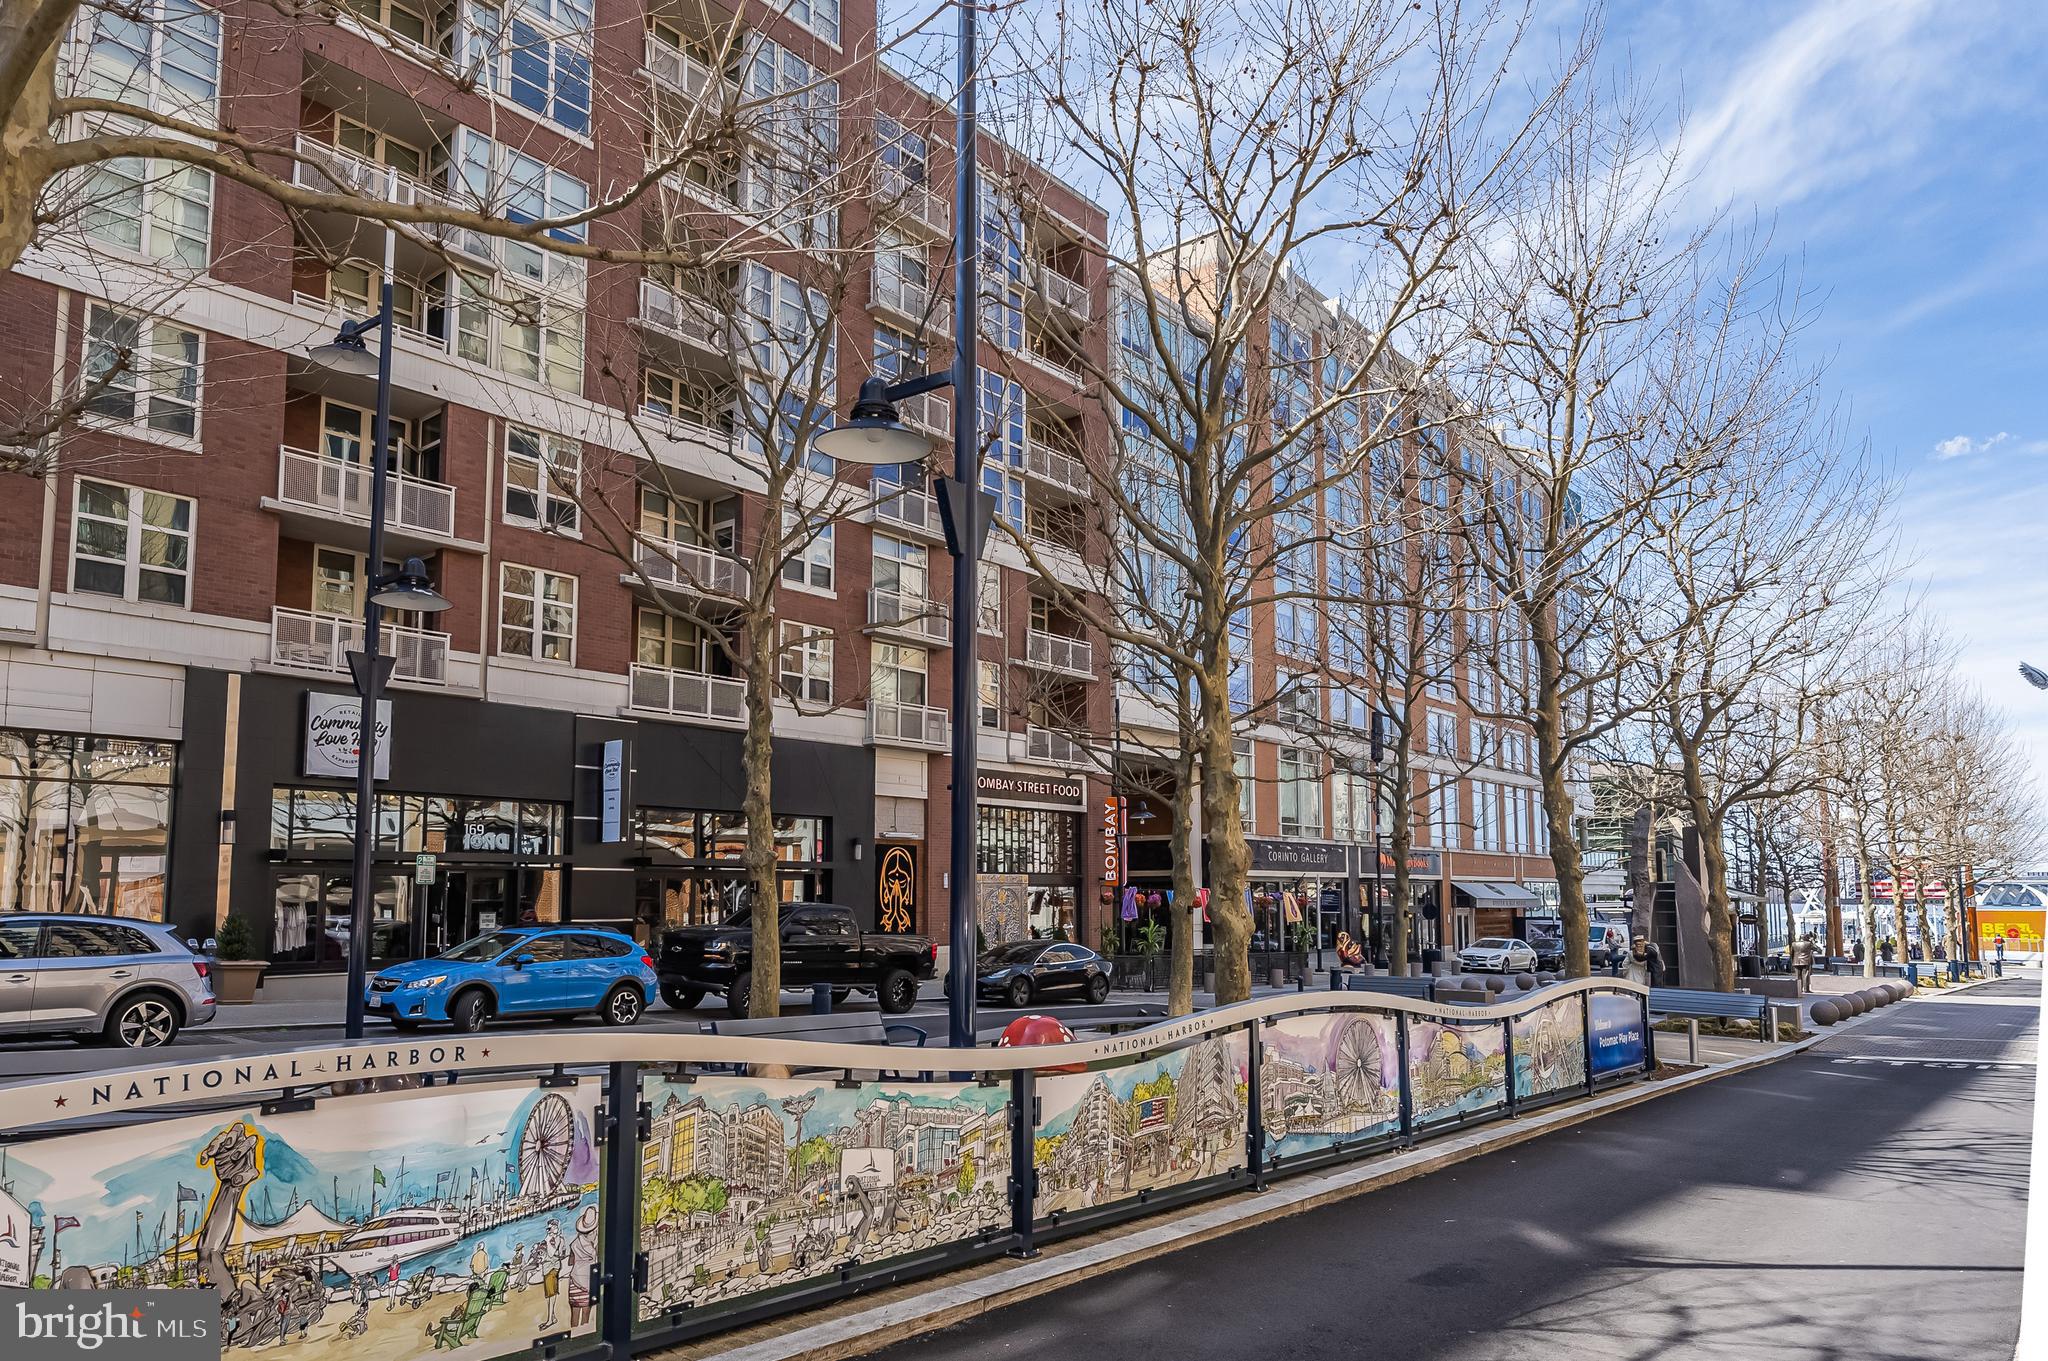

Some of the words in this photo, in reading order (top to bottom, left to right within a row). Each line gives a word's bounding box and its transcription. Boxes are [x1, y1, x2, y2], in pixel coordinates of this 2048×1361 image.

[311, 715, 388, 737] Commuty
[313, 731, 348, 747] Love
[977, 776, 1014, 791] OMBAY
[1017, 780, 1050, 795] STREET
[1053, 784, 1080, 797] FOOD
[464, 823, 484, 835] 169
[1104, 803, 1117, 881] BOMBAY
[1268, 851, 1298, 863] CORINTO
[1301, 852, 1328, 864] GALLERY
[1103, 1035, 1159, 1054] NATIONAL
[1167, 1020, 1206, 1040] HARBOR
[91, 1061, 302, 1106] NATIONAL
[336, 1046, 465, 1072] HARBOR
